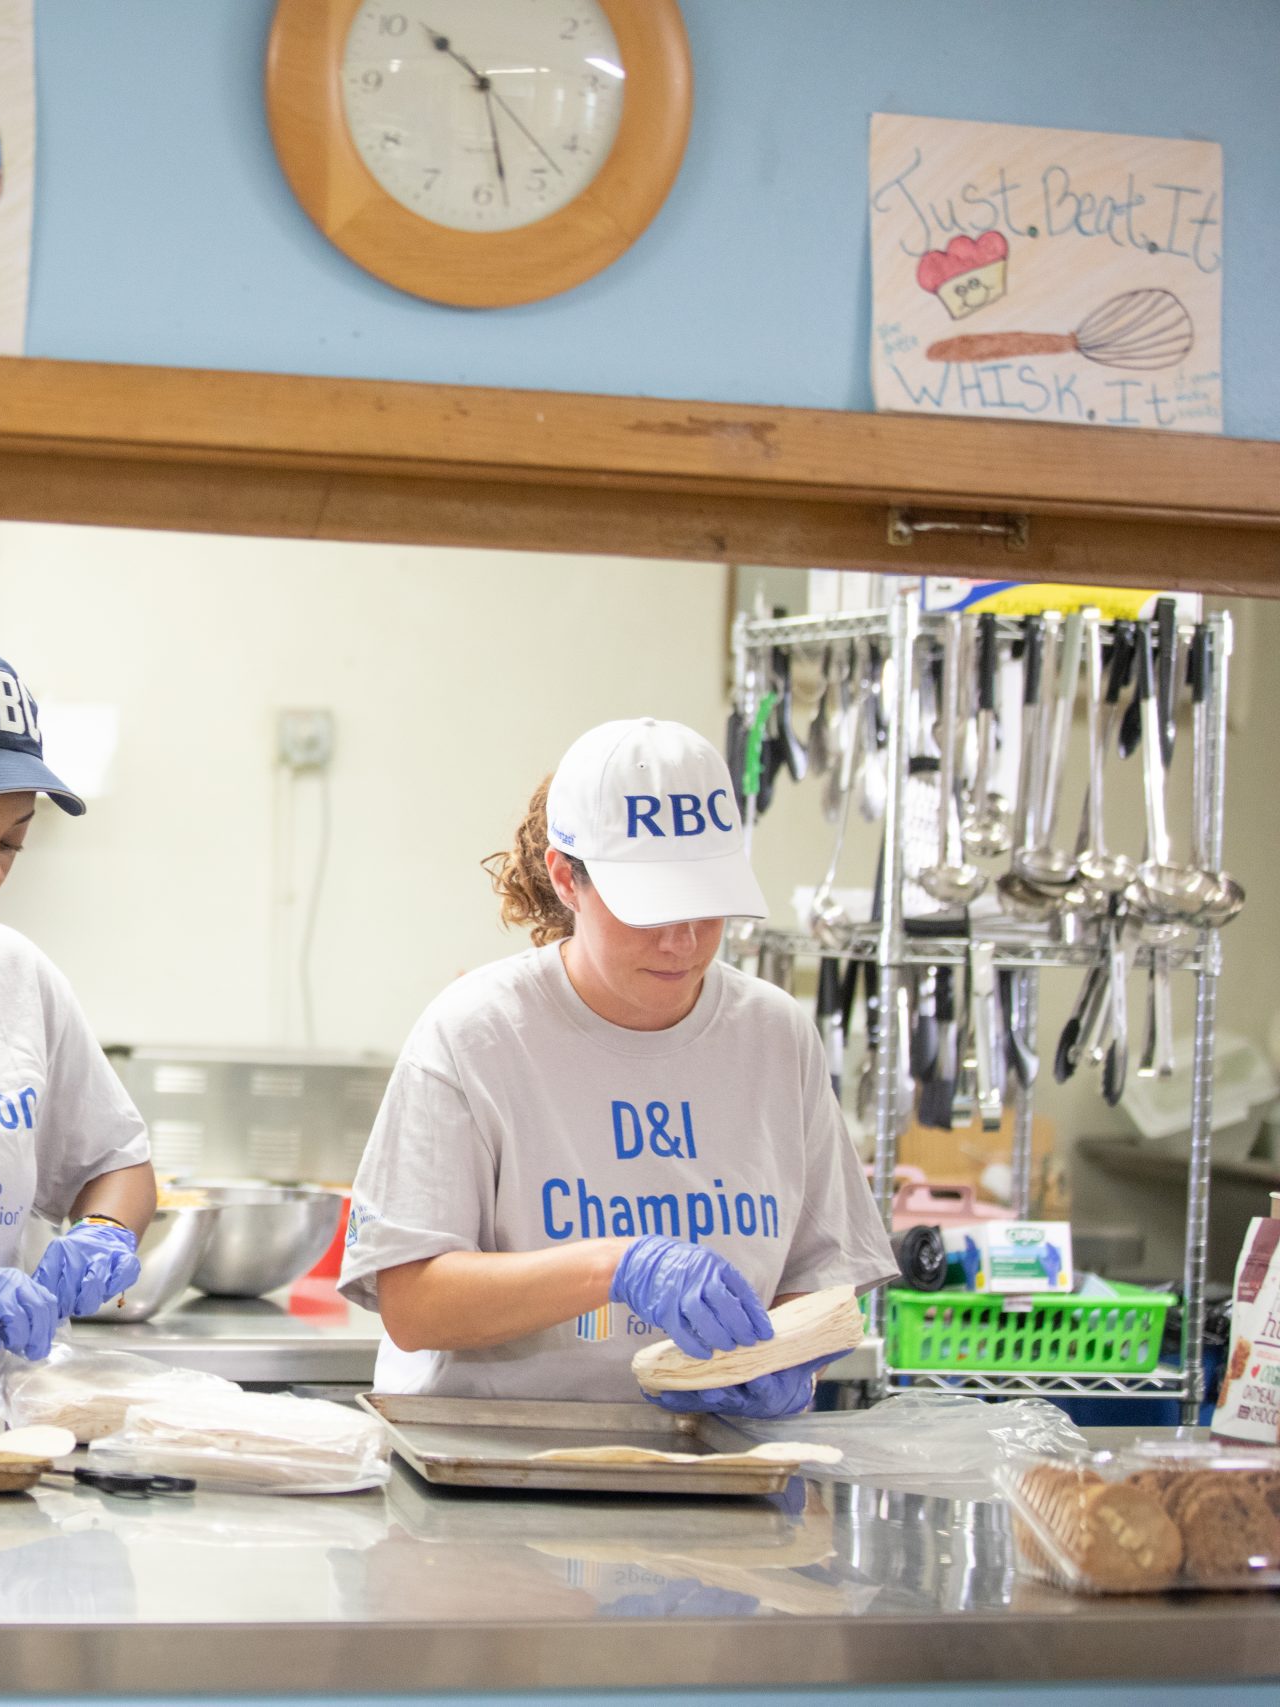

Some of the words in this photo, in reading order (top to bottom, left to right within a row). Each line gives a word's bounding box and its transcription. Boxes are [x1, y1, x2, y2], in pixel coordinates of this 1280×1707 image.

[378, 13, 409, 38] 10
[559, 17, 580, 40] 2
[361, 70, 384, 94] 9
[422, 166, 442, 192] 7
[524, 167, 548, 193] 5
[471, 183, 495, 208] 6
[624, 788, 733, 838] RBC
[611, 1100, 698, 1160] D&I
[542, 1178, 779, 1245] Champion
